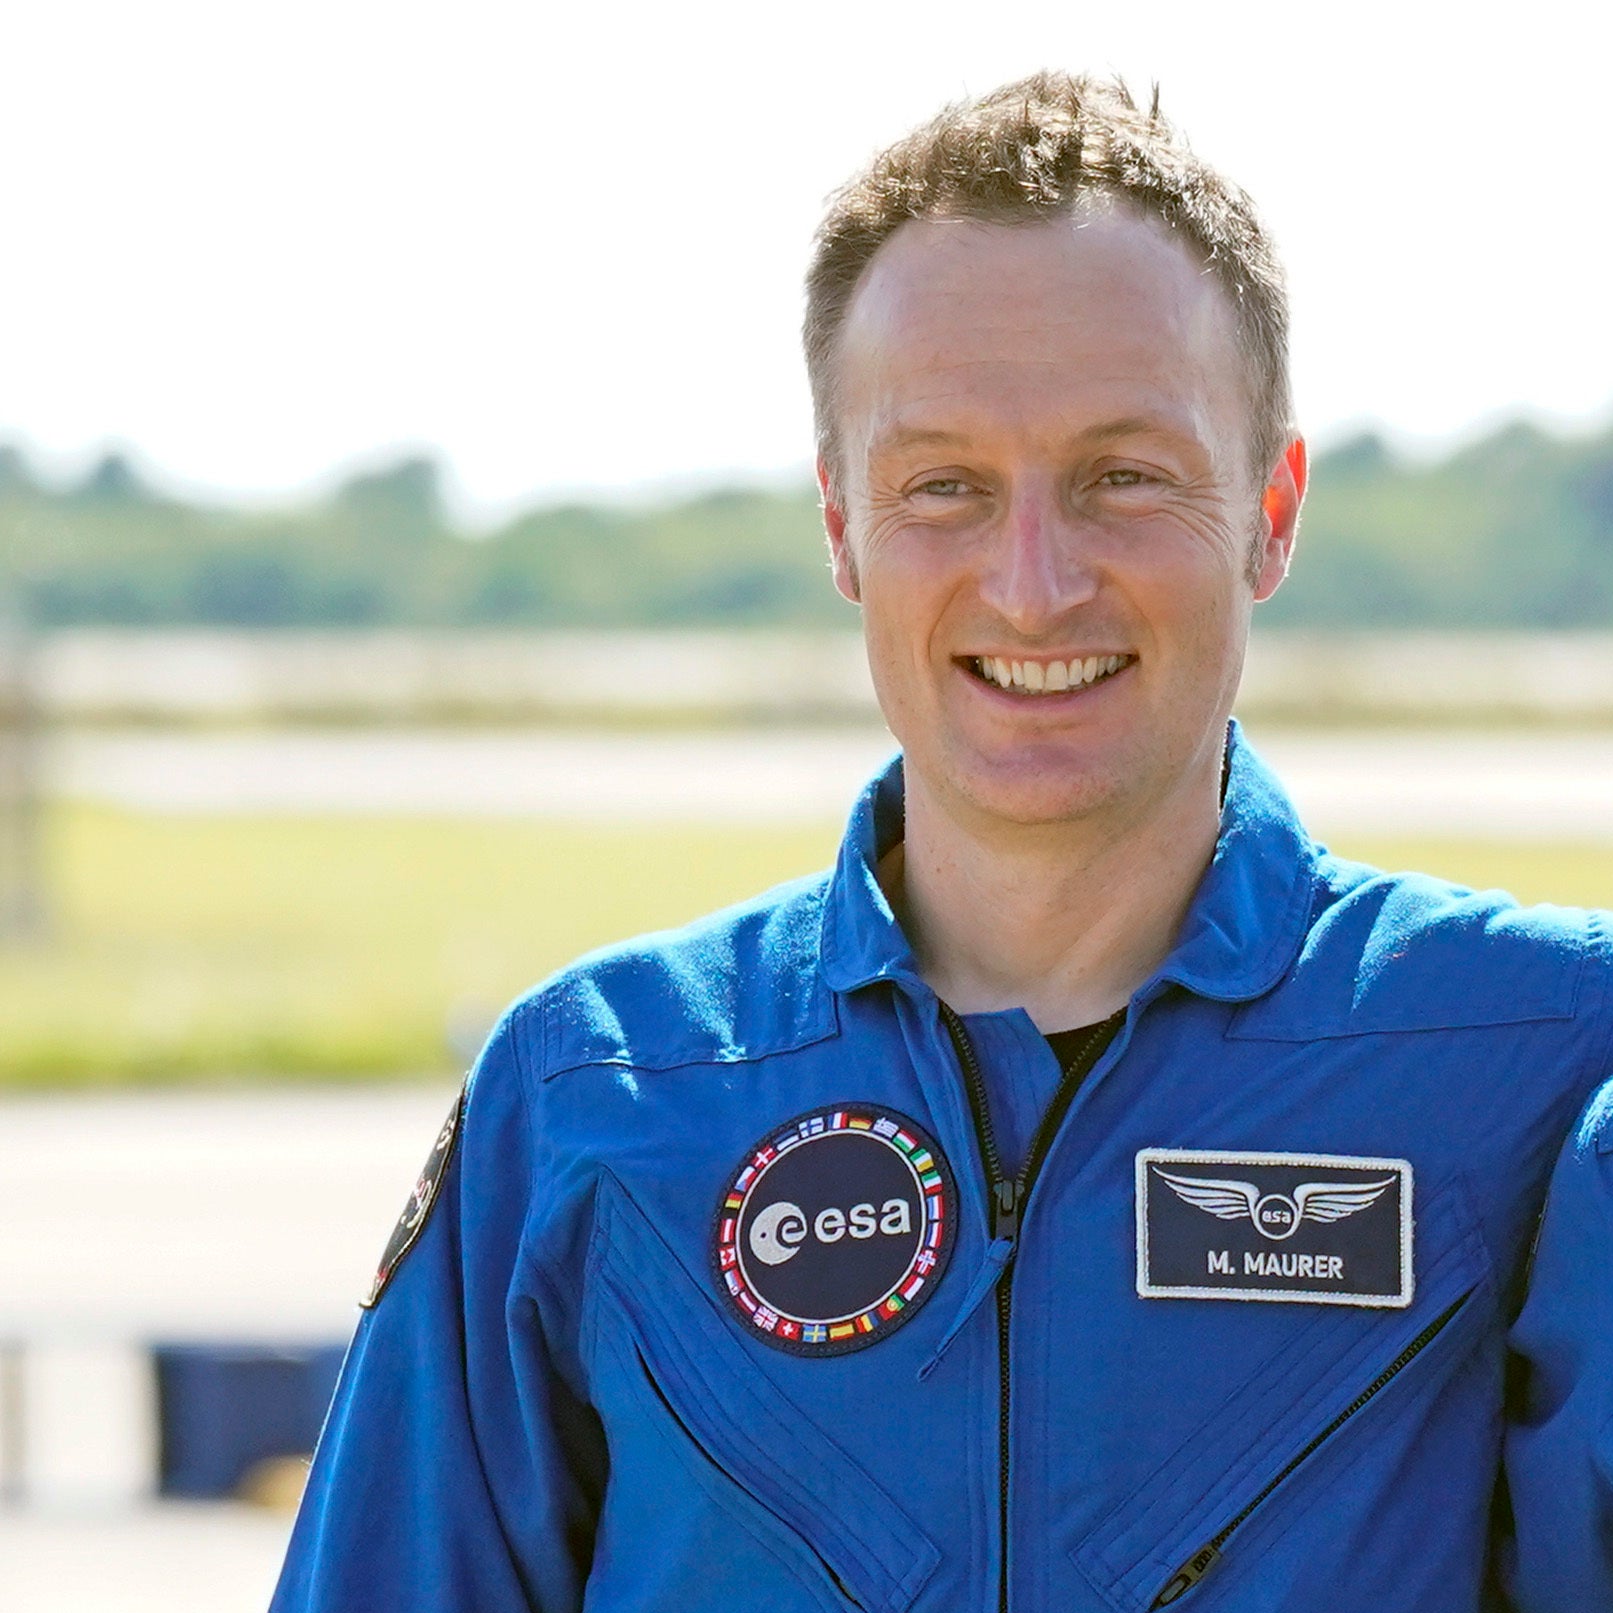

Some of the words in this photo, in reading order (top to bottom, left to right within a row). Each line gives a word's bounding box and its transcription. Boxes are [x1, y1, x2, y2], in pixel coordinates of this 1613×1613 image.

[1262, 1209, 1292, 1225] esa
[1208, 1250, 1235, 1276] M.
[1244, 1252, 1343, 1280] MAURER
